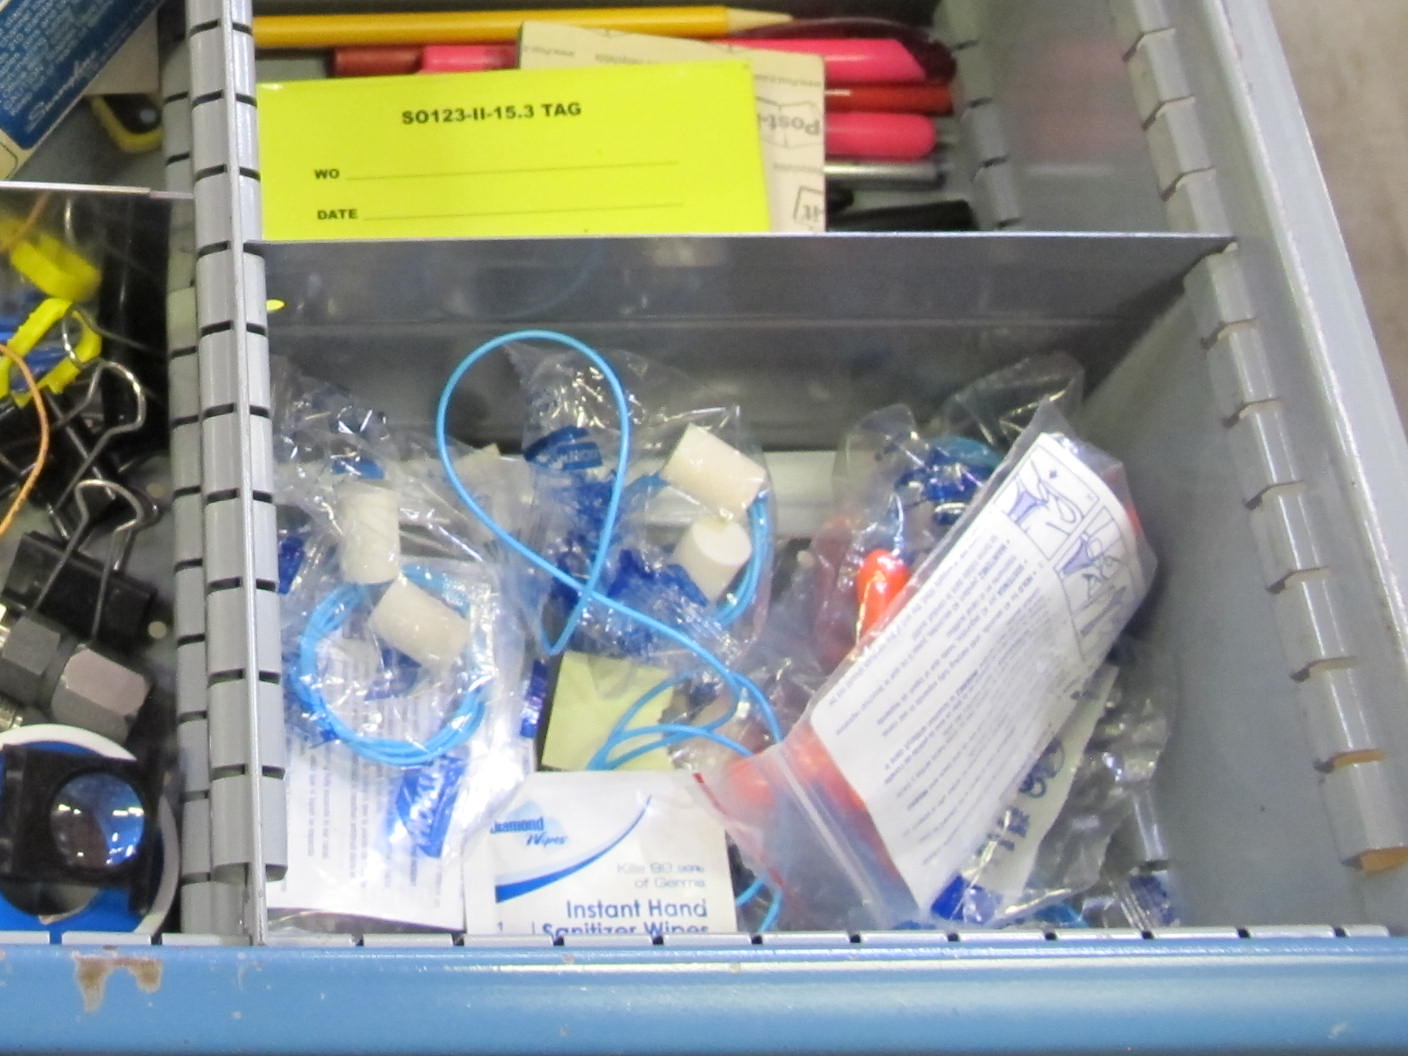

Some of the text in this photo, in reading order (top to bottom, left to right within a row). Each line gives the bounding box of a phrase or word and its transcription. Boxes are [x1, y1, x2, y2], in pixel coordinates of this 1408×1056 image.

[541, 101, 582, 118] TAG
[313, 167, 341, 180] WO
[316, 207, 359, 221] DATE
[566, 898, 709, 920] Instant Hand
[542, 922, 638, 936] Sanitizer
